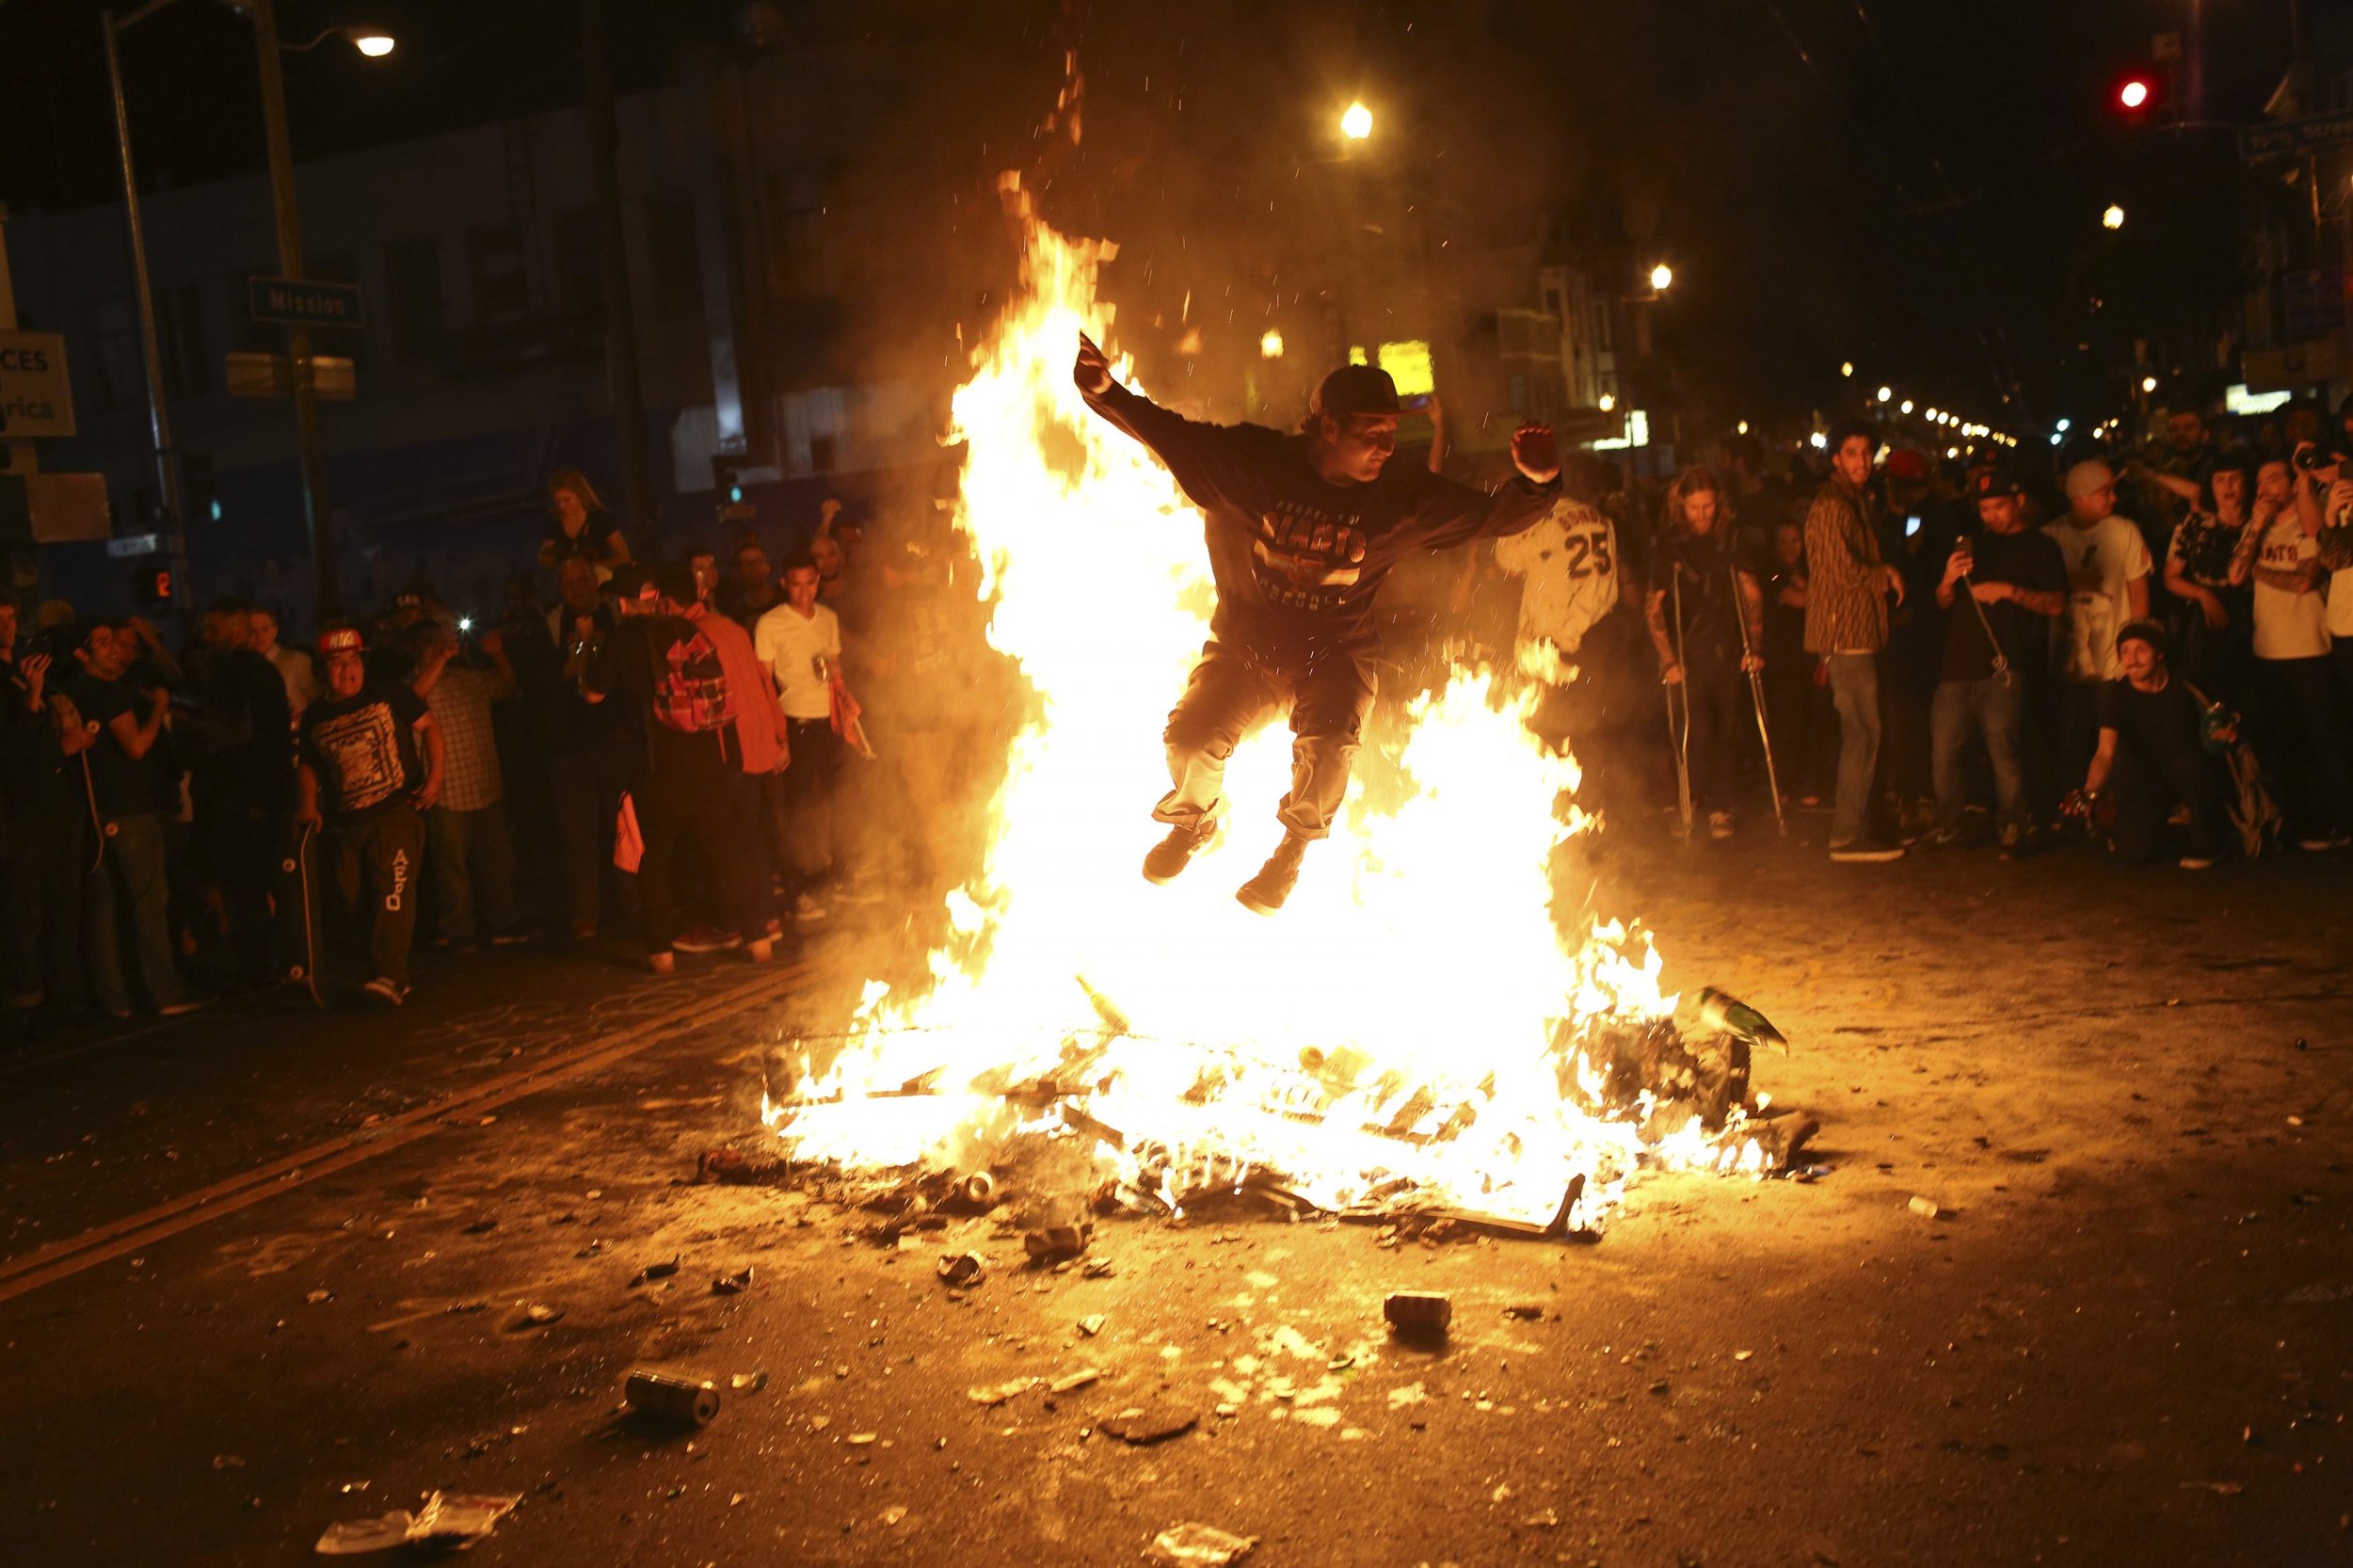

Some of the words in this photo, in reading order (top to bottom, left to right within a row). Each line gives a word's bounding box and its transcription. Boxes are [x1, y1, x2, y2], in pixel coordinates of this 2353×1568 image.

[270, 288, 346, 316] Mission
[1261, 511, 1367, 564] GIANTS
[1565, 533, 1611, 578] 25
